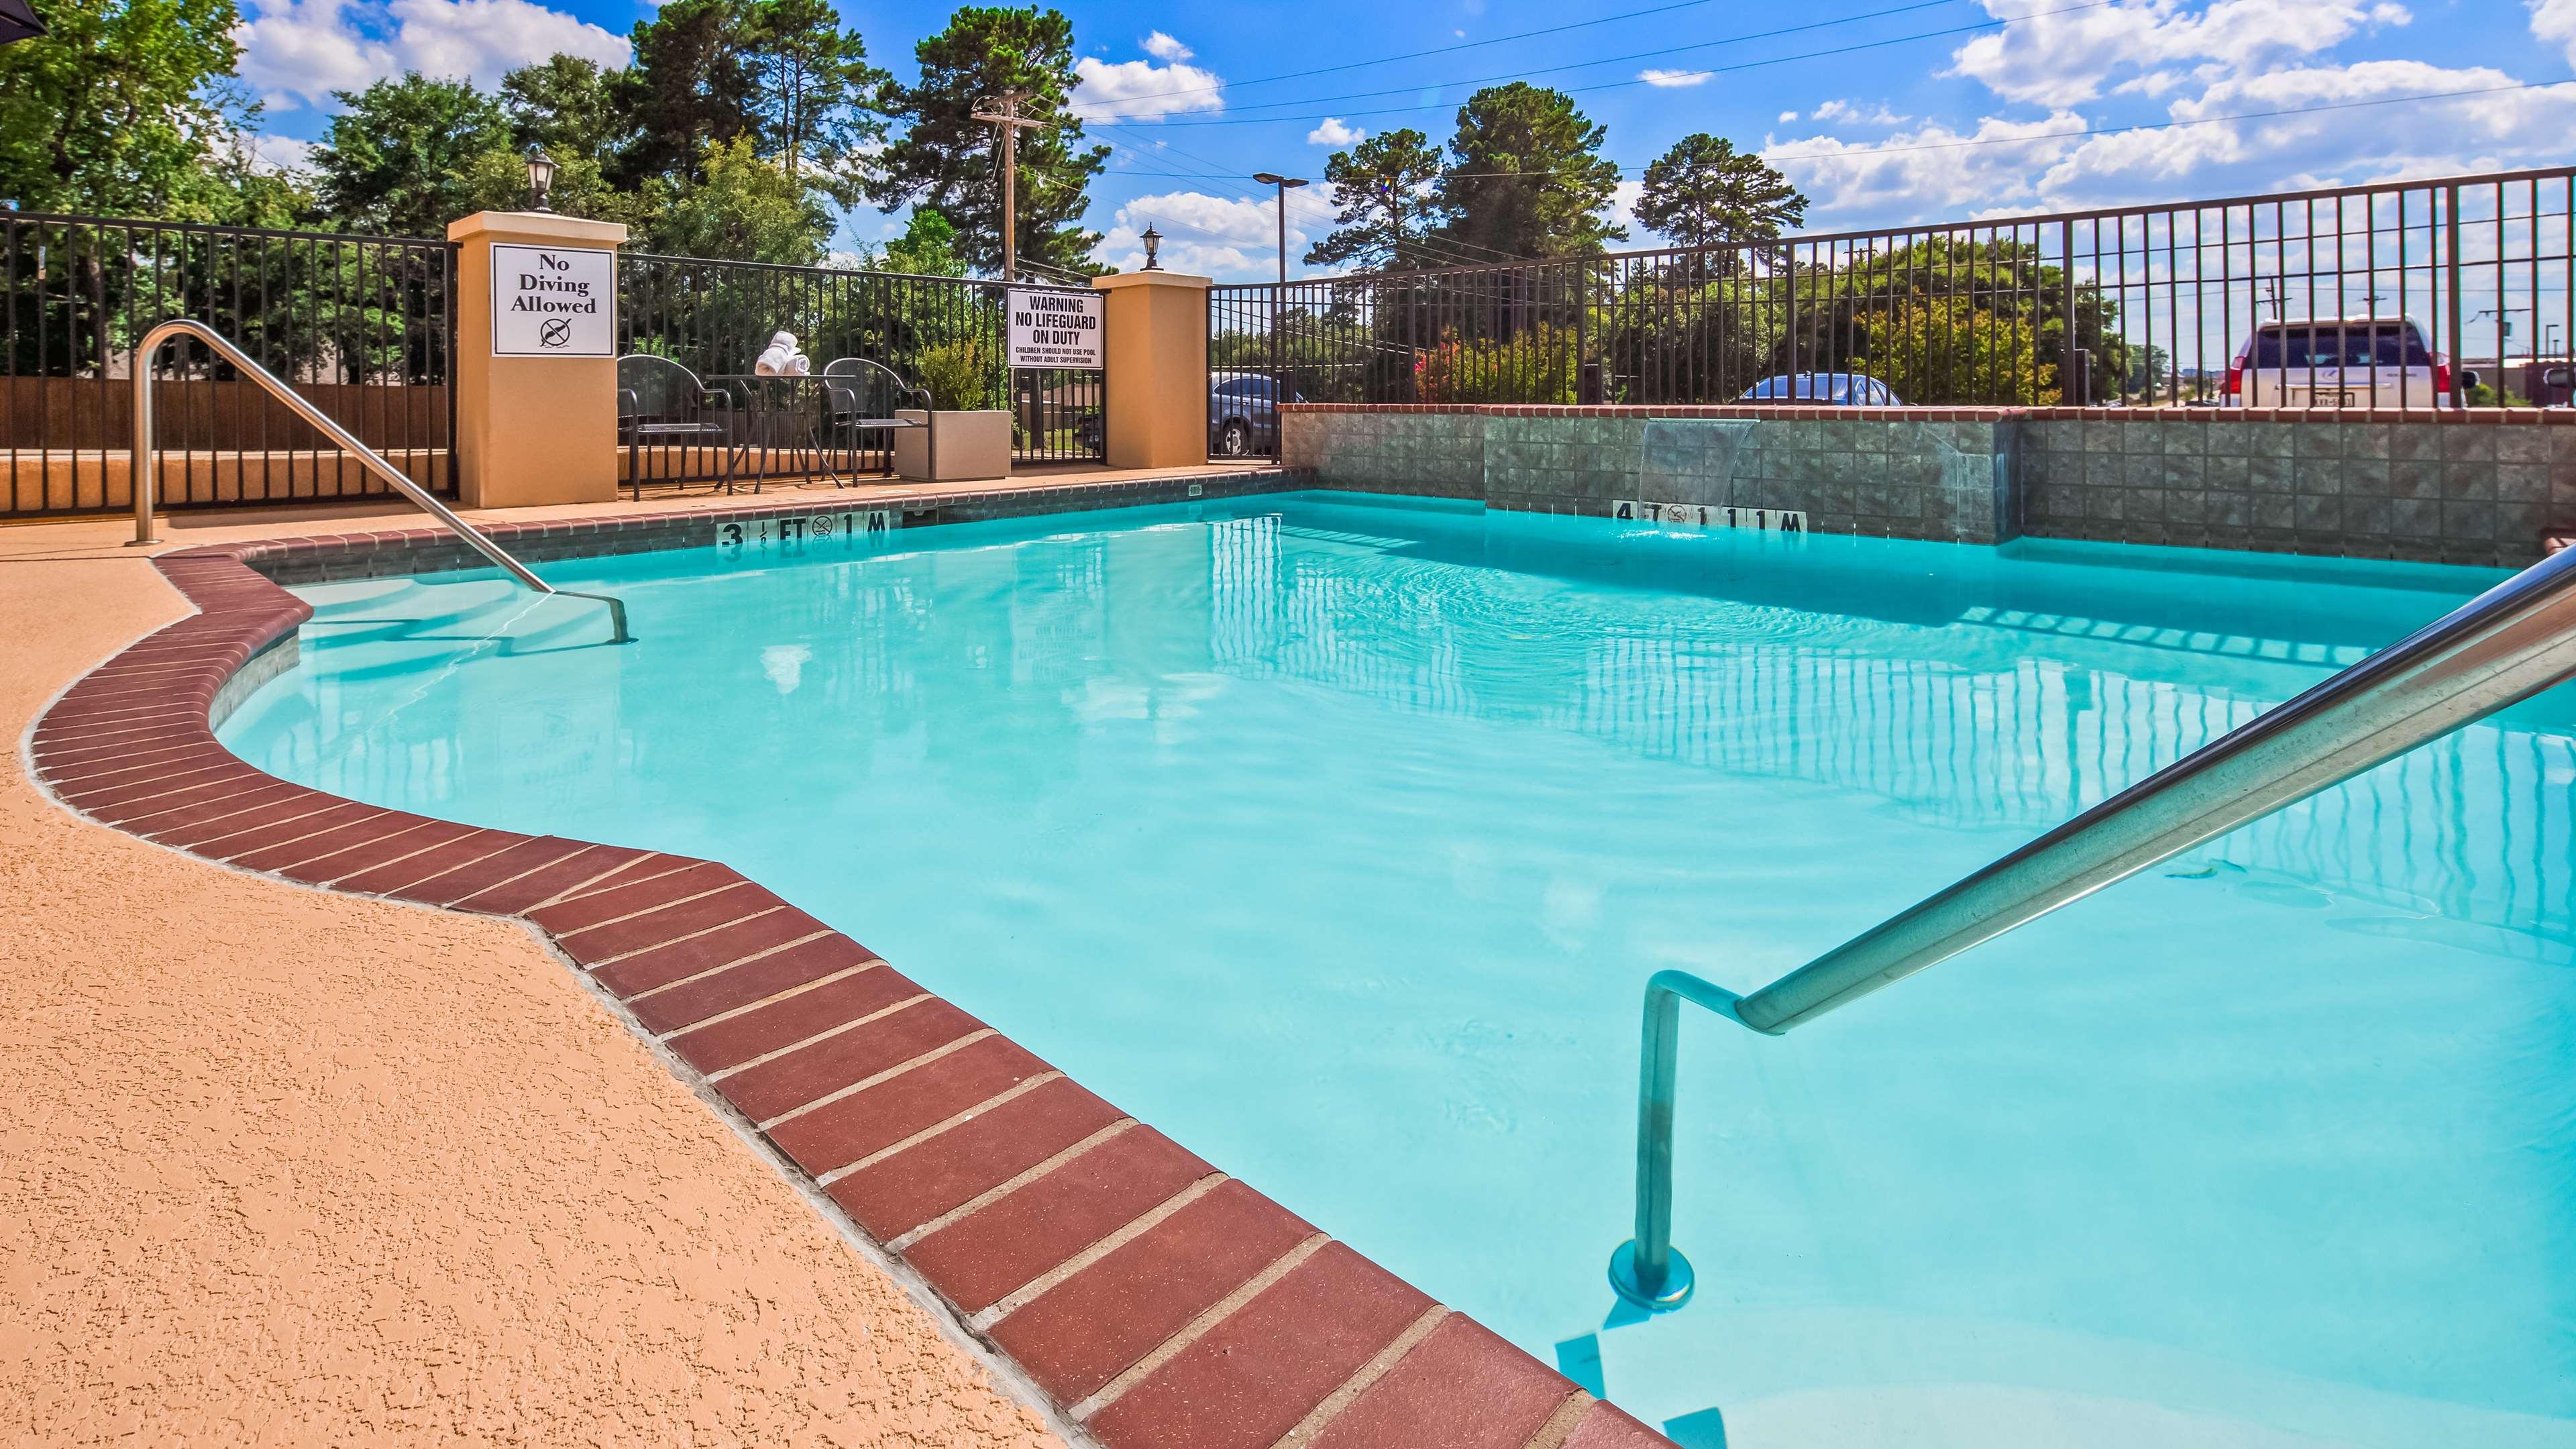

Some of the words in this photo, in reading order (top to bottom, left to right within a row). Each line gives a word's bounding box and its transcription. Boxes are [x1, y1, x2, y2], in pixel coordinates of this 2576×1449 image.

[539, 254, 570, 271] No
[519, 274, 590, 297] Diving
[511, 295, 596, 314] Allowed
[1029, 296, 1083, 313] WARNING
[1016, 312, 1032, 327] NO
[1036, 313, 1096, 330] LIFEGUARD
[1033, 329, 1049, 344] ON
[1053, 331, 1080, 345] DUTY
[1016, 346, 1040, 354] CHILDREN
[722, 523, 743, 546] 3
[780, 518, 806, 540] FT
